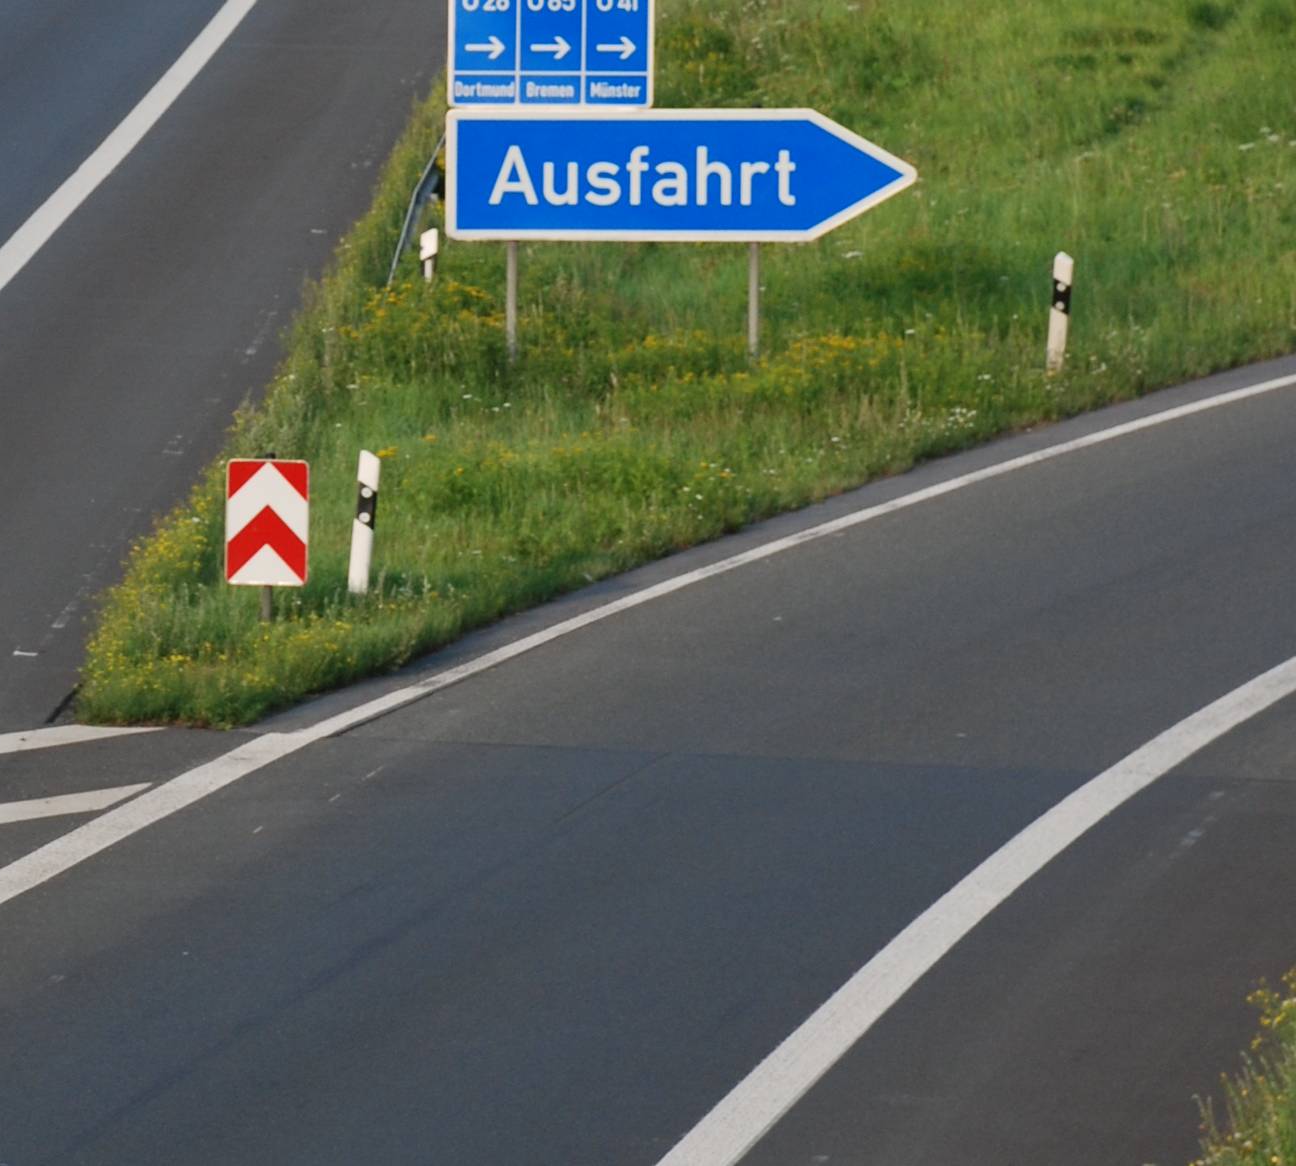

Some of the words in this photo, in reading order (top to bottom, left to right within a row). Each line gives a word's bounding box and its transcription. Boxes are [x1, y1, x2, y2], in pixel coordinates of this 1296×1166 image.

[454, 81, 515, 98] Dortmund
[526, 82, 575, 98] Bremen
[590, 82, 641, 98] Münster
[488, 145, 797, 206] Ausfahrt
